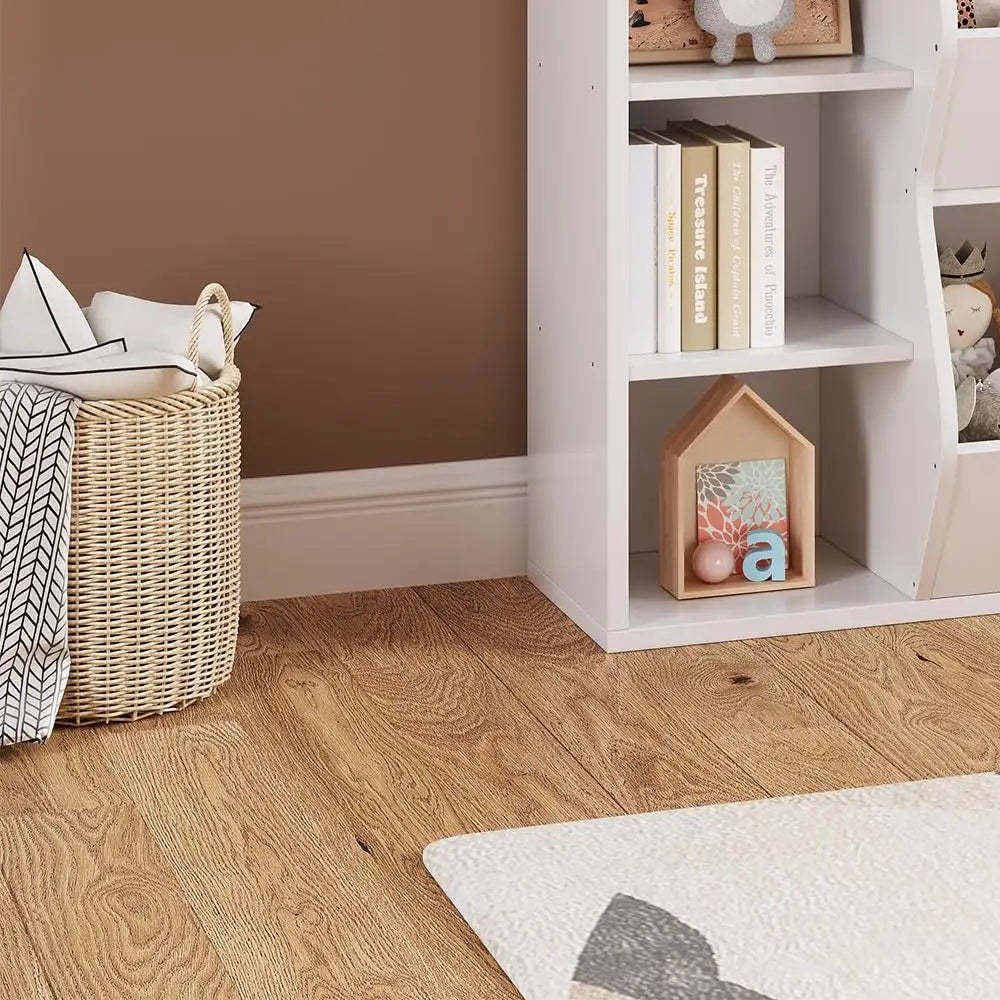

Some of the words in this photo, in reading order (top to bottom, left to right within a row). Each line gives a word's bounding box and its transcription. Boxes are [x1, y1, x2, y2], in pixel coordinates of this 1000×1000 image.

[733, 161, 742, 181] The
[765, 164, 777, 186] The
[667, 212, 676, 241] Space
[694, 174, 708, 261] Treasure
[732, 185, 742, 236] Children
[765, 193, 777, 258] Adventures
[730, 239, 742, 250] of
[668, 248, 676, 287] Pirates
[765, 264, 776, 275] of
[694, 266, 708, 324] Island
[765, 283, 777, 336] Pinocchio
[743, 529, 785, 582] a
